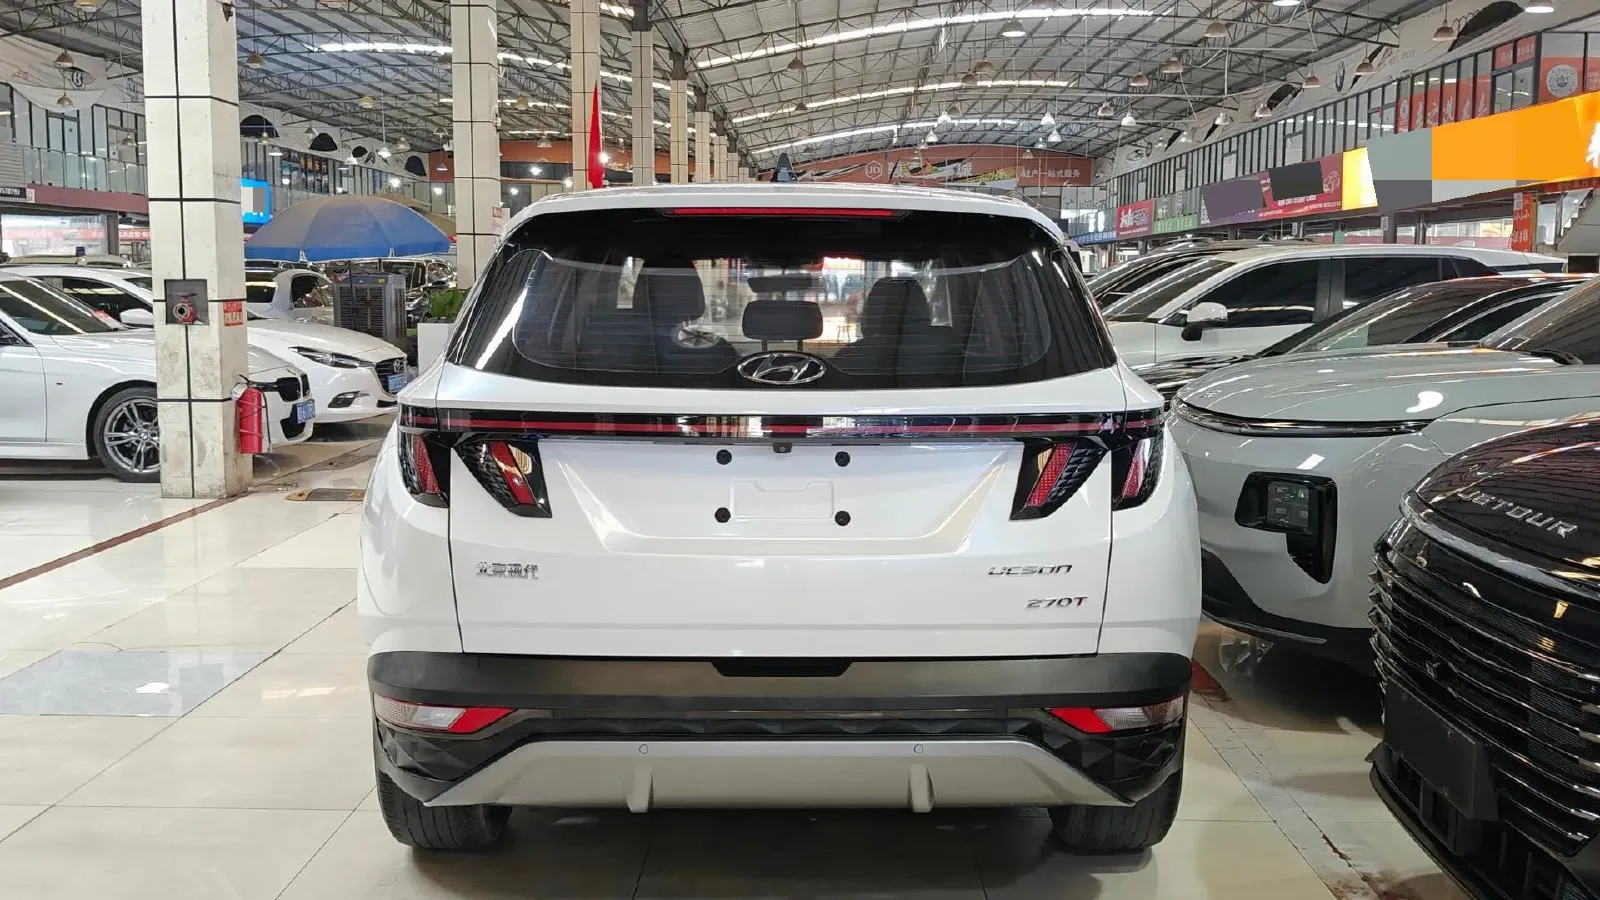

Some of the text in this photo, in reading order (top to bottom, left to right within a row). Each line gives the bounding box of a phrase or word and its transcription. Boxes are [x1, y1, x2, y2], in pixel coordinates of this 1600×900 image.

[867, 166, 880, 174] JD
[1457, 490, 1578, 539] JETOUR
[1026, 596, 1089, 608] 270T
